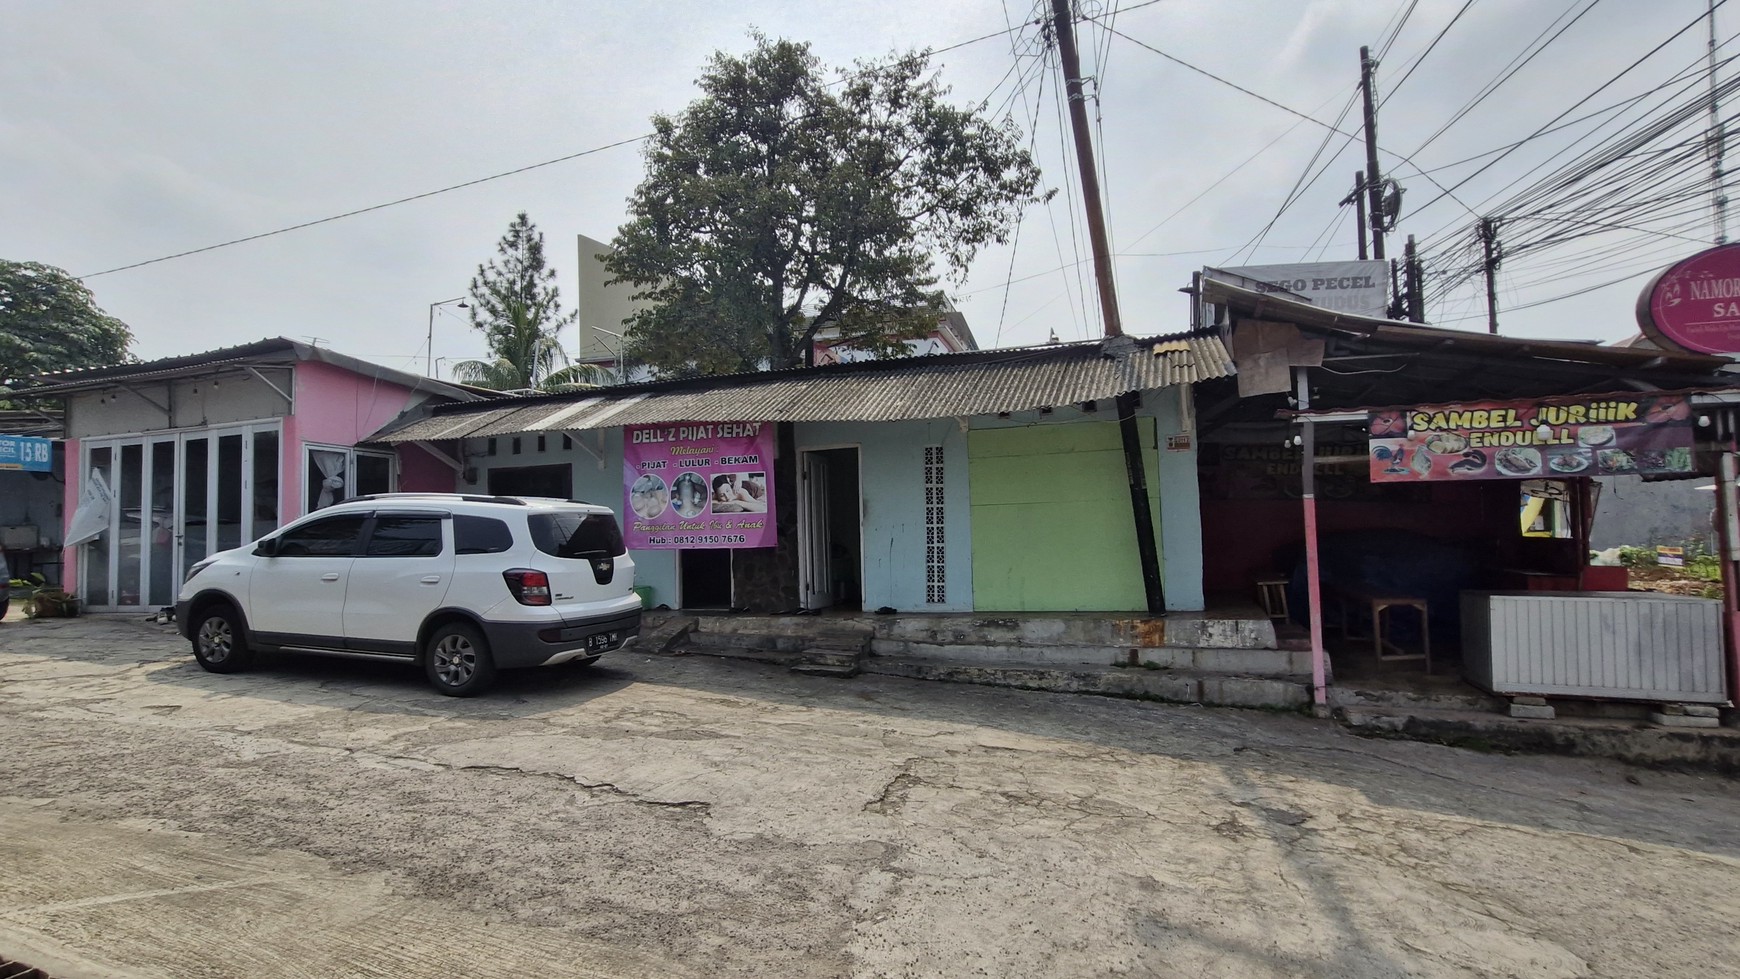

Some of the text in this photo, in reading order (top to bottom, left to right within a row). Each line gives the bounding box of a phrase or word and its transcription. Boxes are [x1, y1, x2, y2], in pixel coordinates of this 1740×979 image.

[1312, 276, 1376, 290] PECEL
[1412, 408, 1522, 431] SAMBEL
[679, 424, 714, 441] PIJAT
[717, 422, 761, 438] SEHAT
[20, 441, 49, 463] 15 RB
[670, 444, 714, 456] Melayani
[633, 521, 675, 534] Panggilan
[679, 520, 705, 532] Untuk
[736, 519, 764, 530] Anak
[674, 535, 695, 544] 0812
[698, 535, 719, 544] 9150
[722, 534, 745, 543] 7676
[588, 637, 593, 647] B
